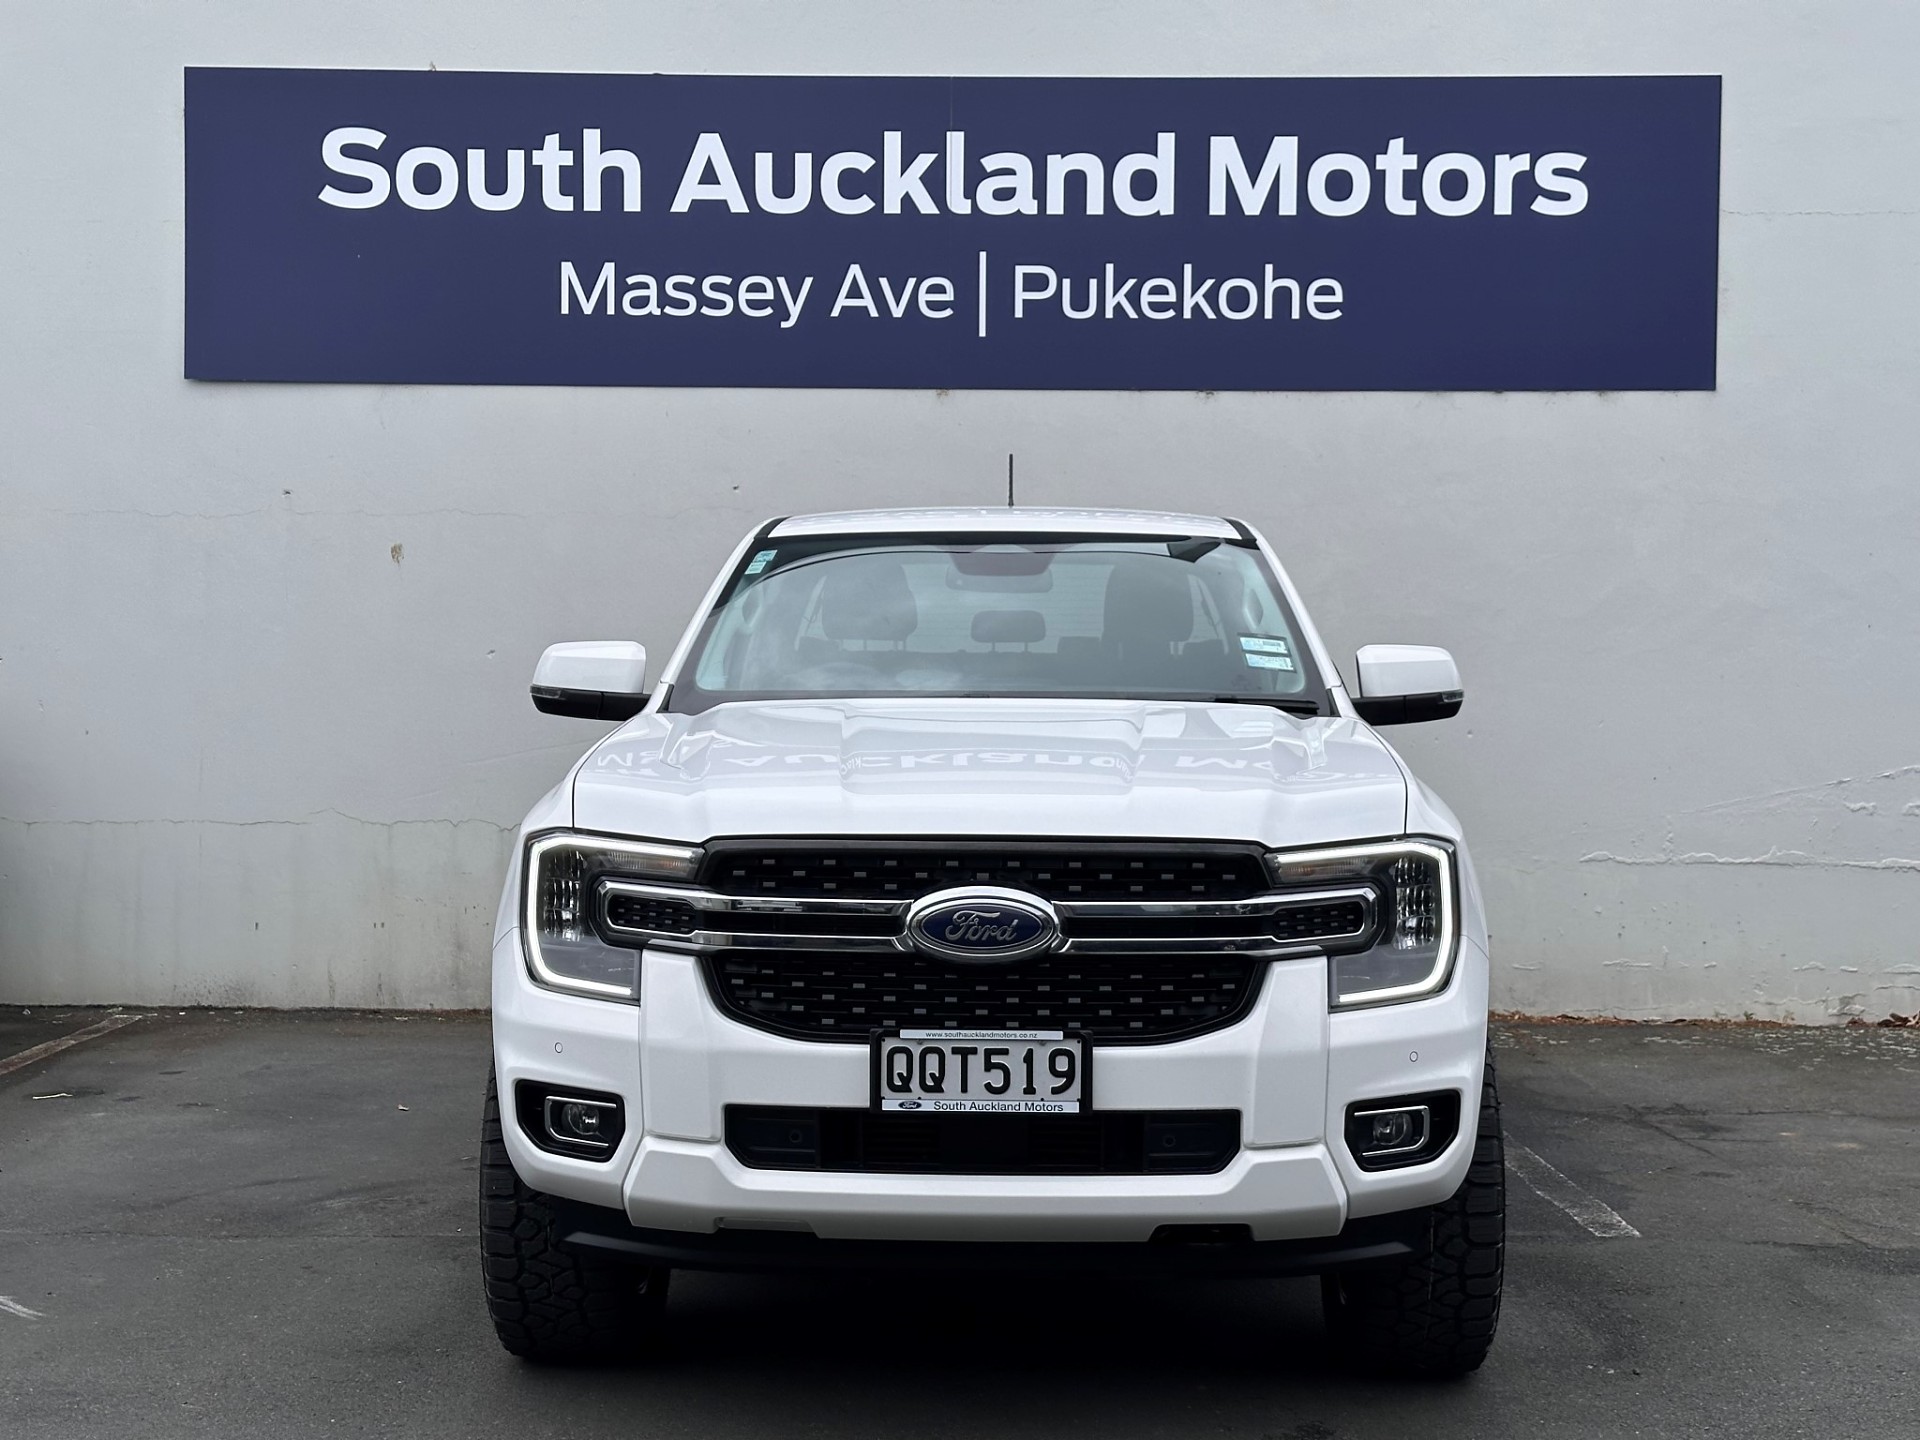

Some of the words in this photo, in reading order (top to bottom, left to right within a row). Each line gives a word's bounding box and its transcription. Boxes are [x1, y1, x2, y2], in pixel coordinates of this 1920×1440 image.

[317, 127, 642, 212] South
[669, 130, 1176, 217] Auckland
[1208, 135, 1589, 217] Motors
[560, 261, 814, 329] Massey
[830, 263, 955, 319] Ave
[1014, 263, 1344, 322] Pukekohe
[944, 910, 1019, 941] Ford
[925, 1031, 1038, 1040] www.southaucklandmotors.co.nz
[886, 1045, 1076, 1095] QQT519
[933, 1101, 966, 1111] South
[968, 1101, 1021, 1112] Auckland
[1024, 1102, 1064, 1112] Motors
